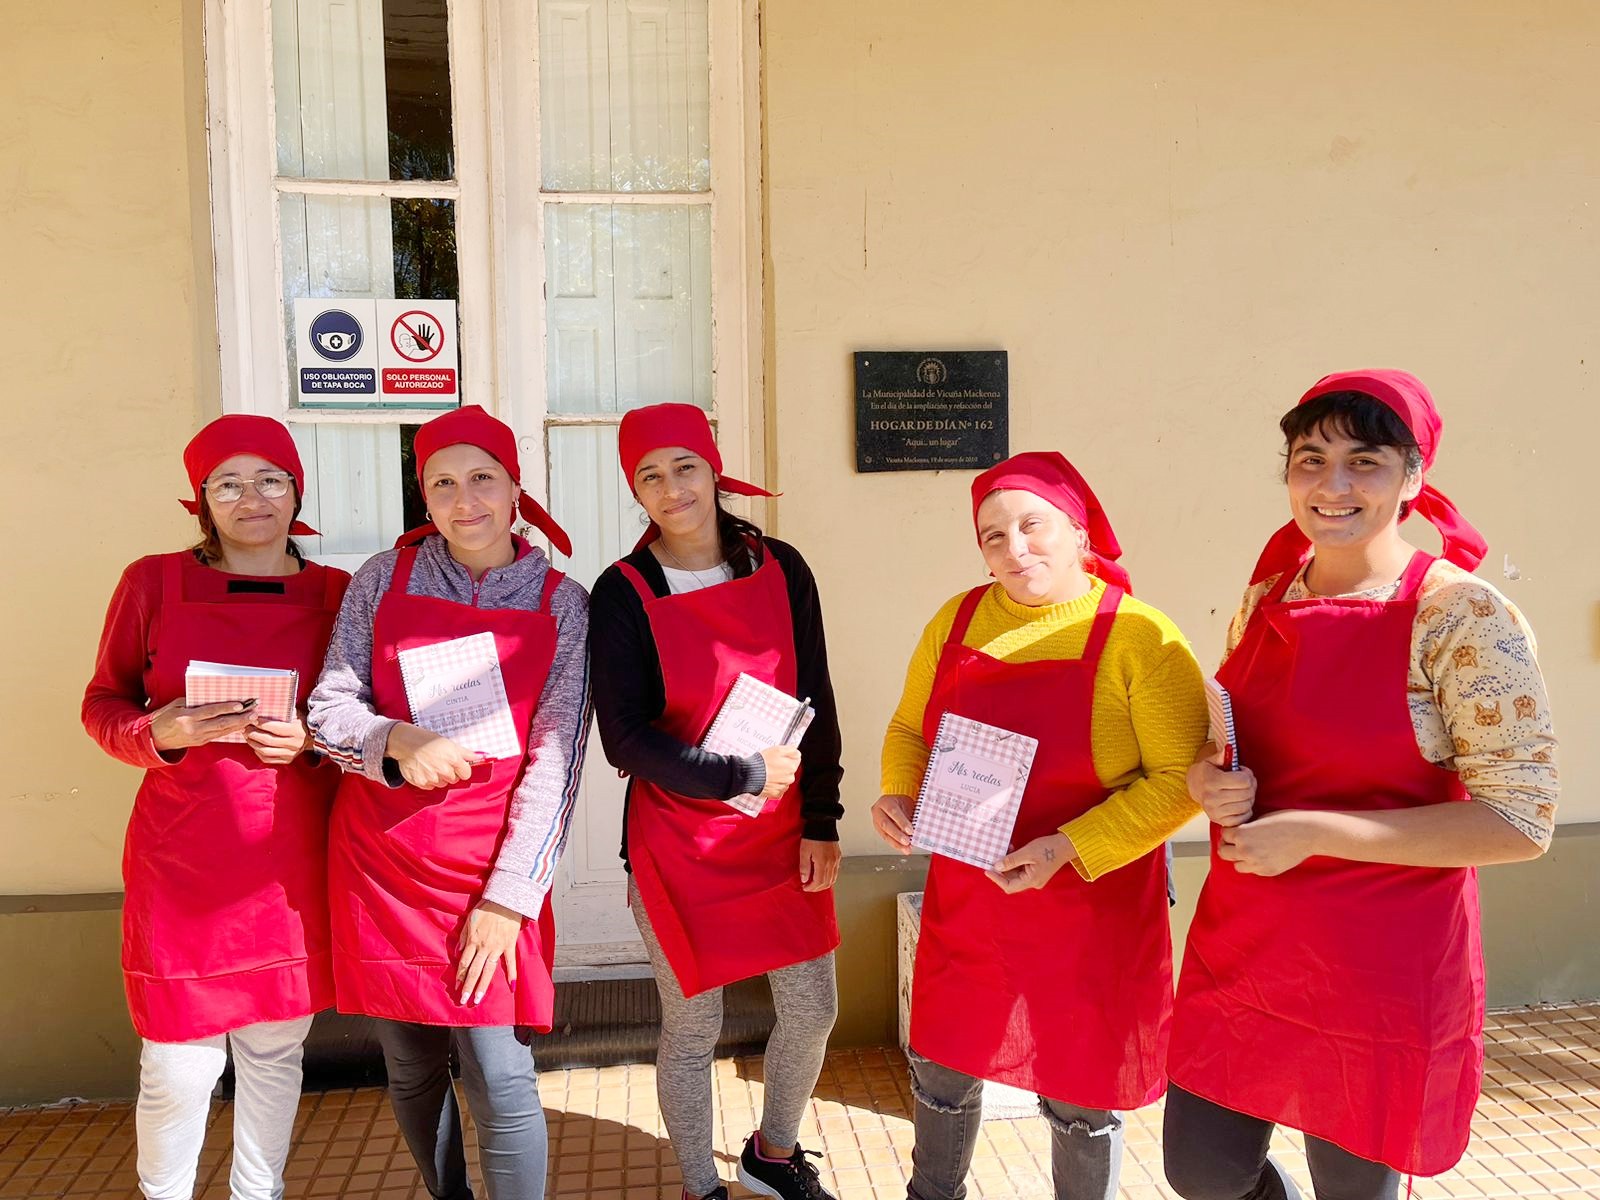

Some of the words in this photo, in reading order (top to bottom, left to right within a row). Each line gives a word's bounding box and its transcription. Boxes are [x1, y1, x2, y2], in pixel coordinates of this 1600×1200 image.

[303, 373, 320, 381] USO
[321, 373, 373, 381] OBLIGATORIO
[862, 390, 871, 398] La
[873, 389, 925, 400] Municipalidad
[926, 390, 935, 398] de
[936, 389, 962, 398] Vicuña
[963, 389, 1001, 398] Mackenna
[870, 402, 880, 410] En
[880, 402, 887, 410] el
[898, 402, 906, 410] de
[906, 402, 913, 410] la
[983, 402, 993, 410] del
[870, 420, 915, 431] HOGAR
[917, 420, 934, 431] DE
[936, 418, 957, 430] DÍA
[975, 420, 994, 430] 162
[929, 439, 939, 447] un
[428, 683, 447, 698] Mis
[452, 679, 481, 692] recetas
[445, 695, 469, 706] CINTIA
[948, 761, 967, 776] Mis
[973, 771, 1001, 787] recetas
